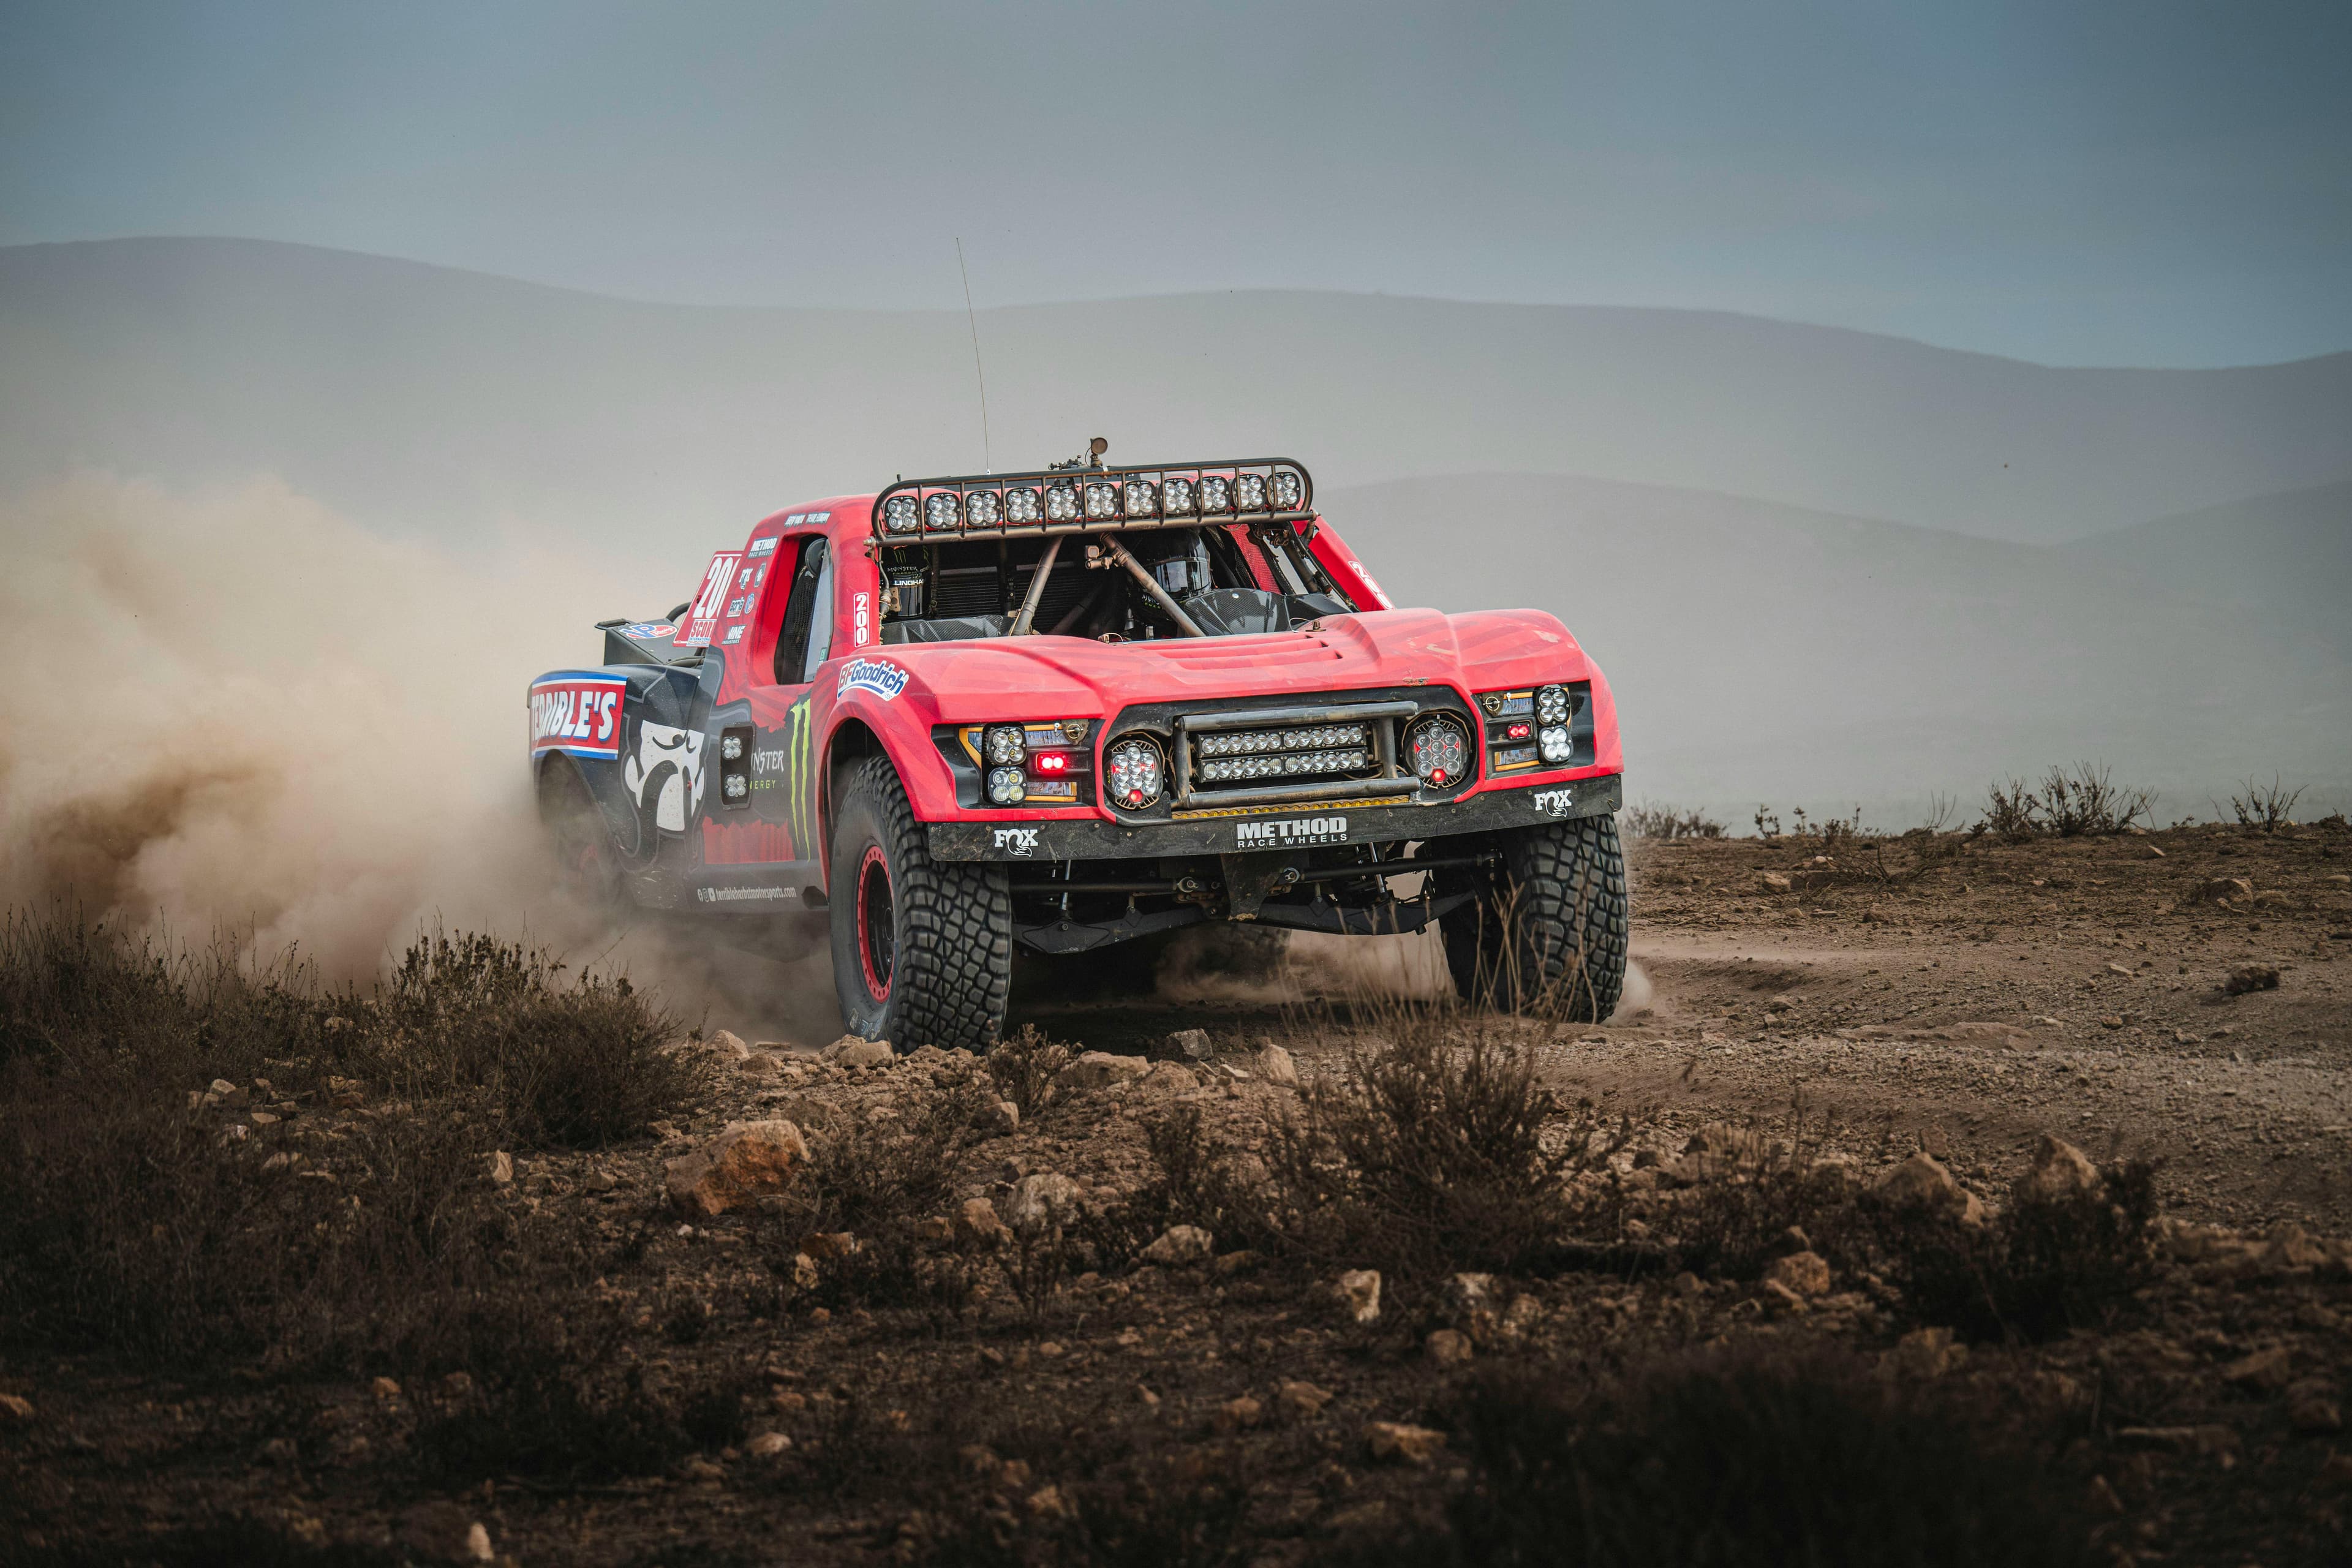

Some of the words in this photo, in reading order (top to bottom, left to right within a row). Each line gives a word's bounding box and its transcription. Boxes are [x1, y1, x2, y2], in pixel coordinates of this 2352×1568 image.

[750, 537, 778, 552] METHOD
[620, 624, 657, 638] VP
[856, 594, 867, 644] 200
[839, 660, 905, 695] BFGoodrich
[532, 691, 617, 741] TERRIBLE'S
[751, 747, 784, 774] NSTER
[1534, 789, 1572, 818] FOX
[1237, 816, 1347, 840] METHOD
[1237, 838, 1276, 848] RACE
[1284, 834, 1348, 845] WHEELS
[994, 829, 1039, 858] FOX
[715, 886, 797, 901] terribleherbstmotorsports.com
